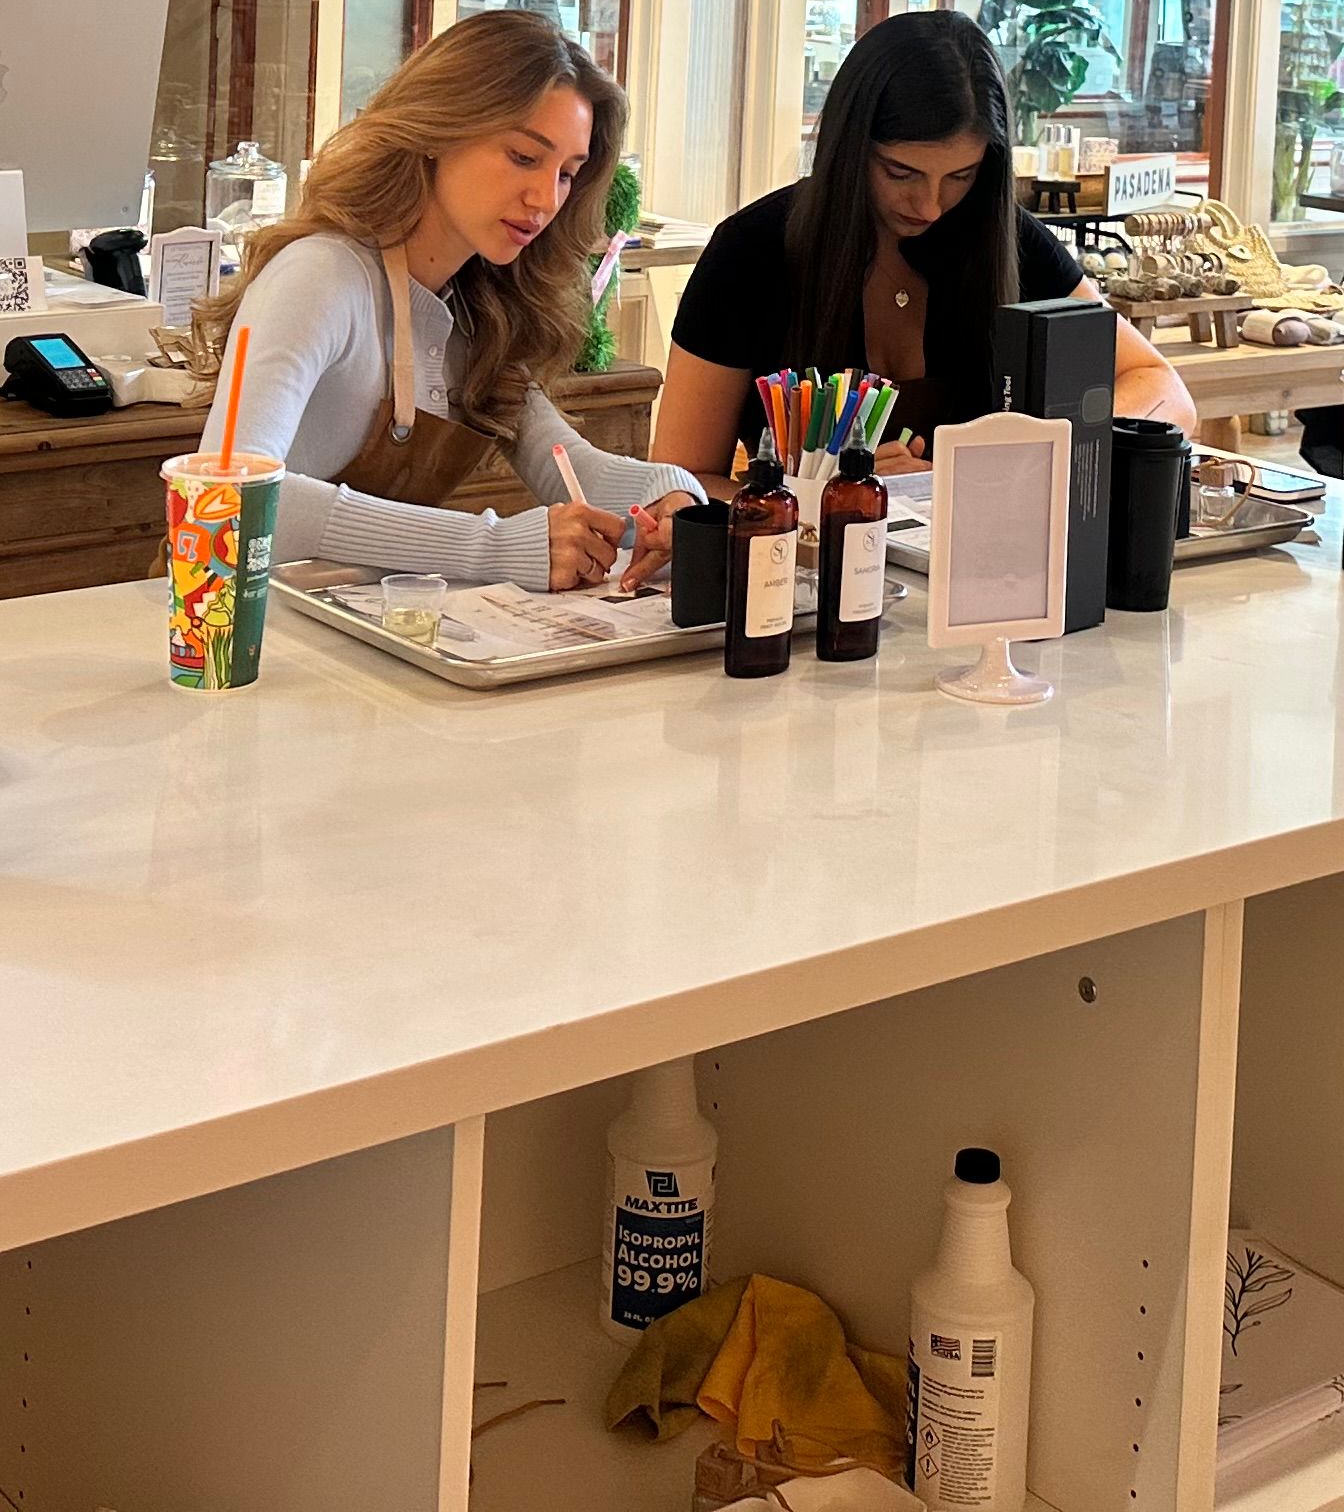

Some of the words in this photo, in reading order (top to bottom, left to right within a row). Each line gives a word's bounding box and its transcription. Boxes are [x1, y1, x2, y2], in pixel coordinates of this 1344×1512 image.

[1114, 167, 1171, 202] PASADENA
[624, 1195, 698, 1214] MAXTITE
[618, 1225, 701, 1249] ISOPROPYL
[618, 1243, 700, 1269] ALCOHOL
[617, 1264, 698, 1294] 99.9%
